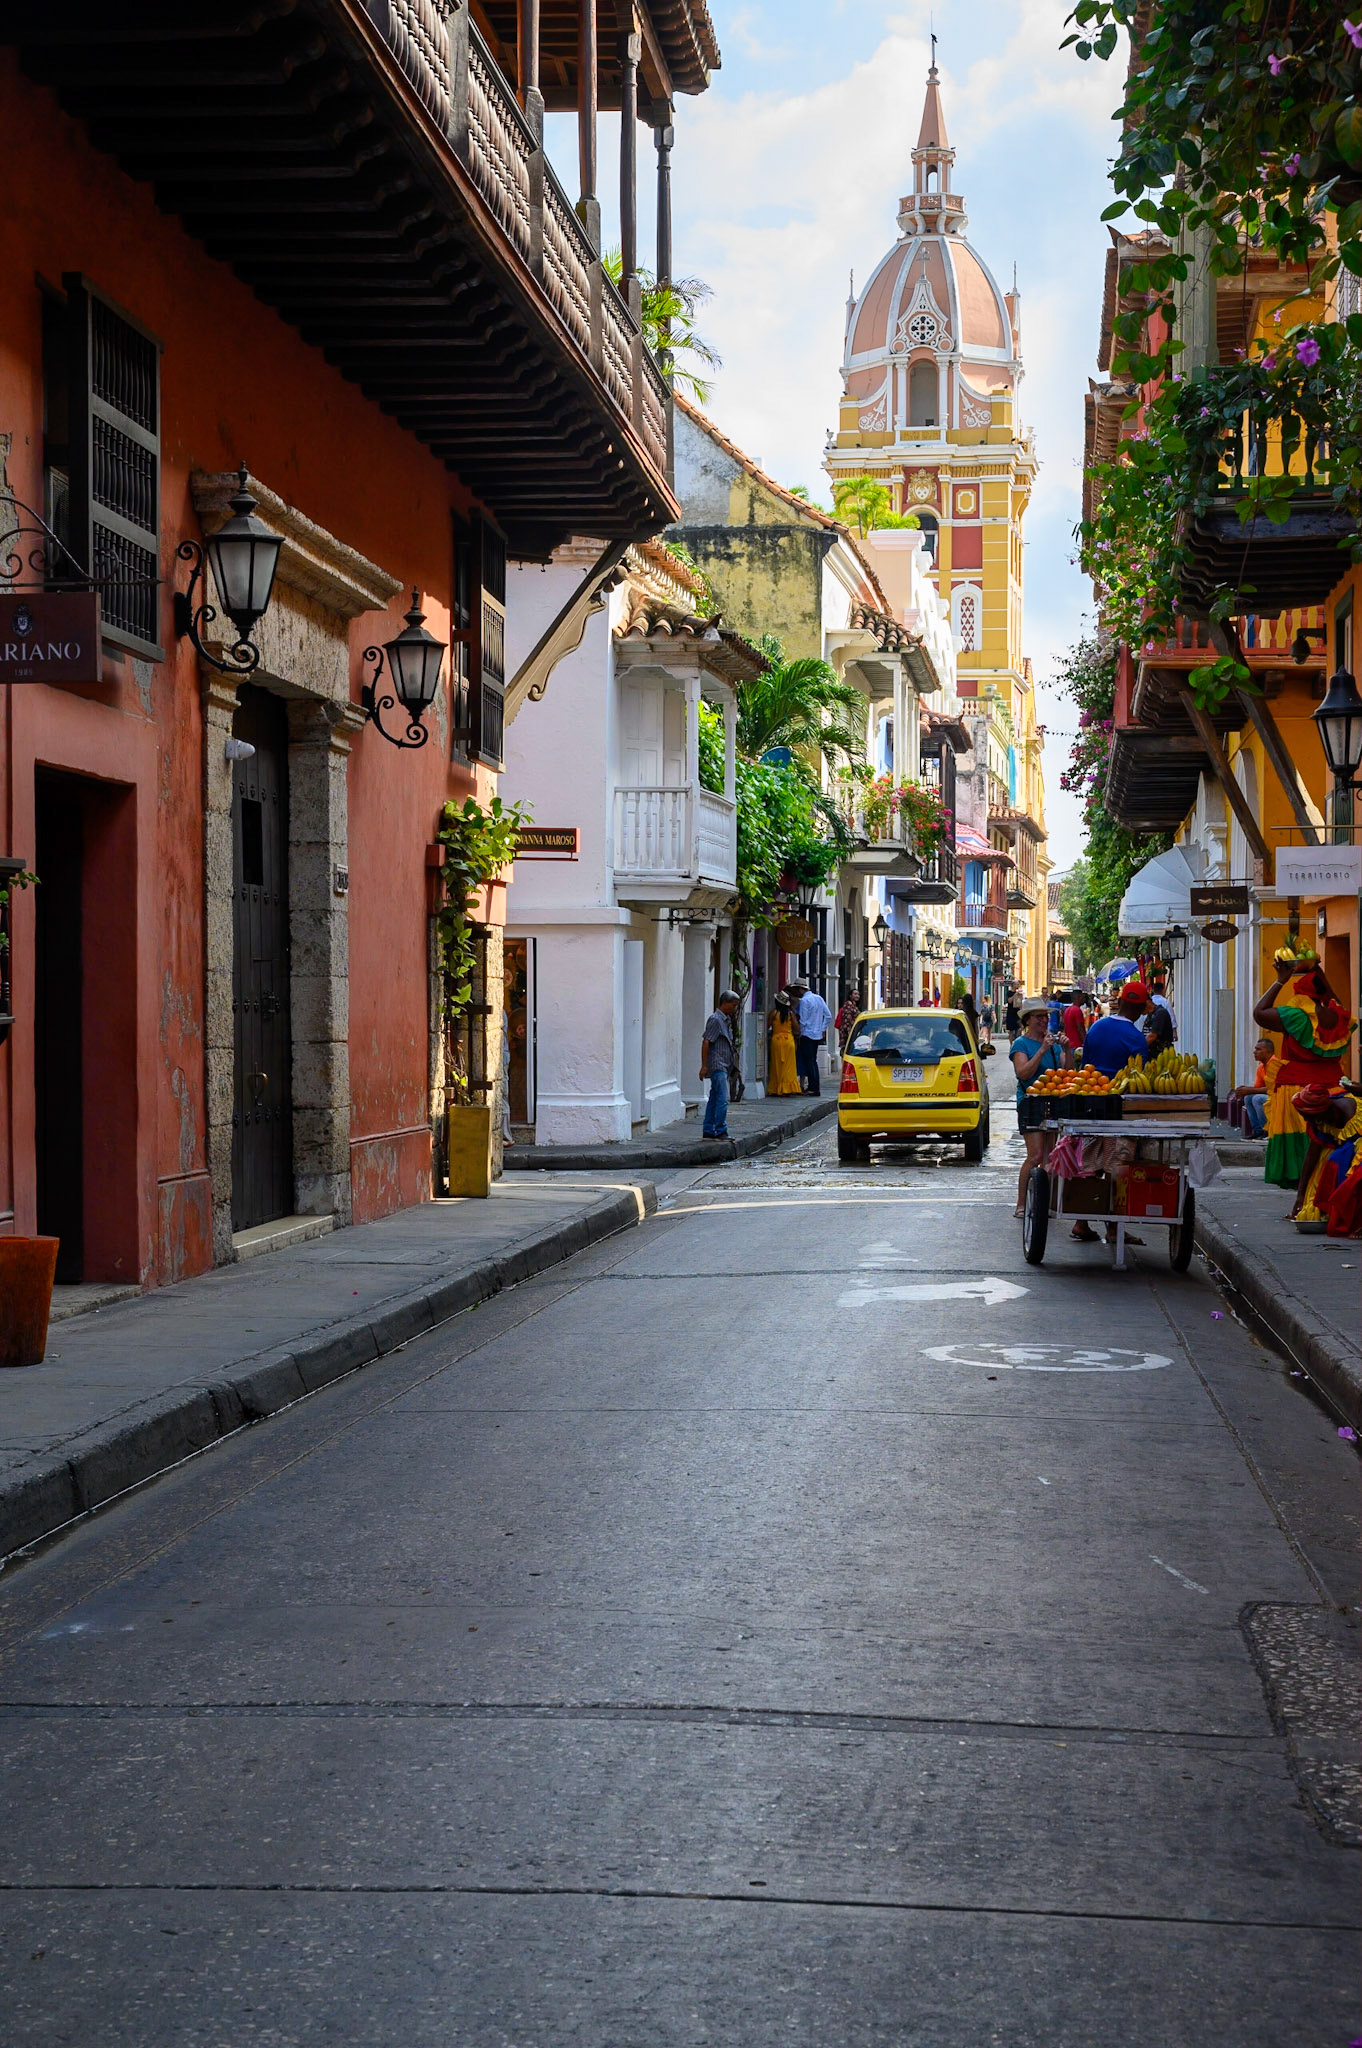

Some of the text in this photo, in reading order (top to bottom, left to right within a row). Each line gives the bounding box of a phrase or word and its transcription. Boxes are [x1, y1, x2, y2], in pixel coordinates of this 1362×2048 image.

[0, 642, 81, 661] RIANO
[544, 834, 576, 846] MAROSO
[1289, 872, 1350, 880] TERRITORIO
